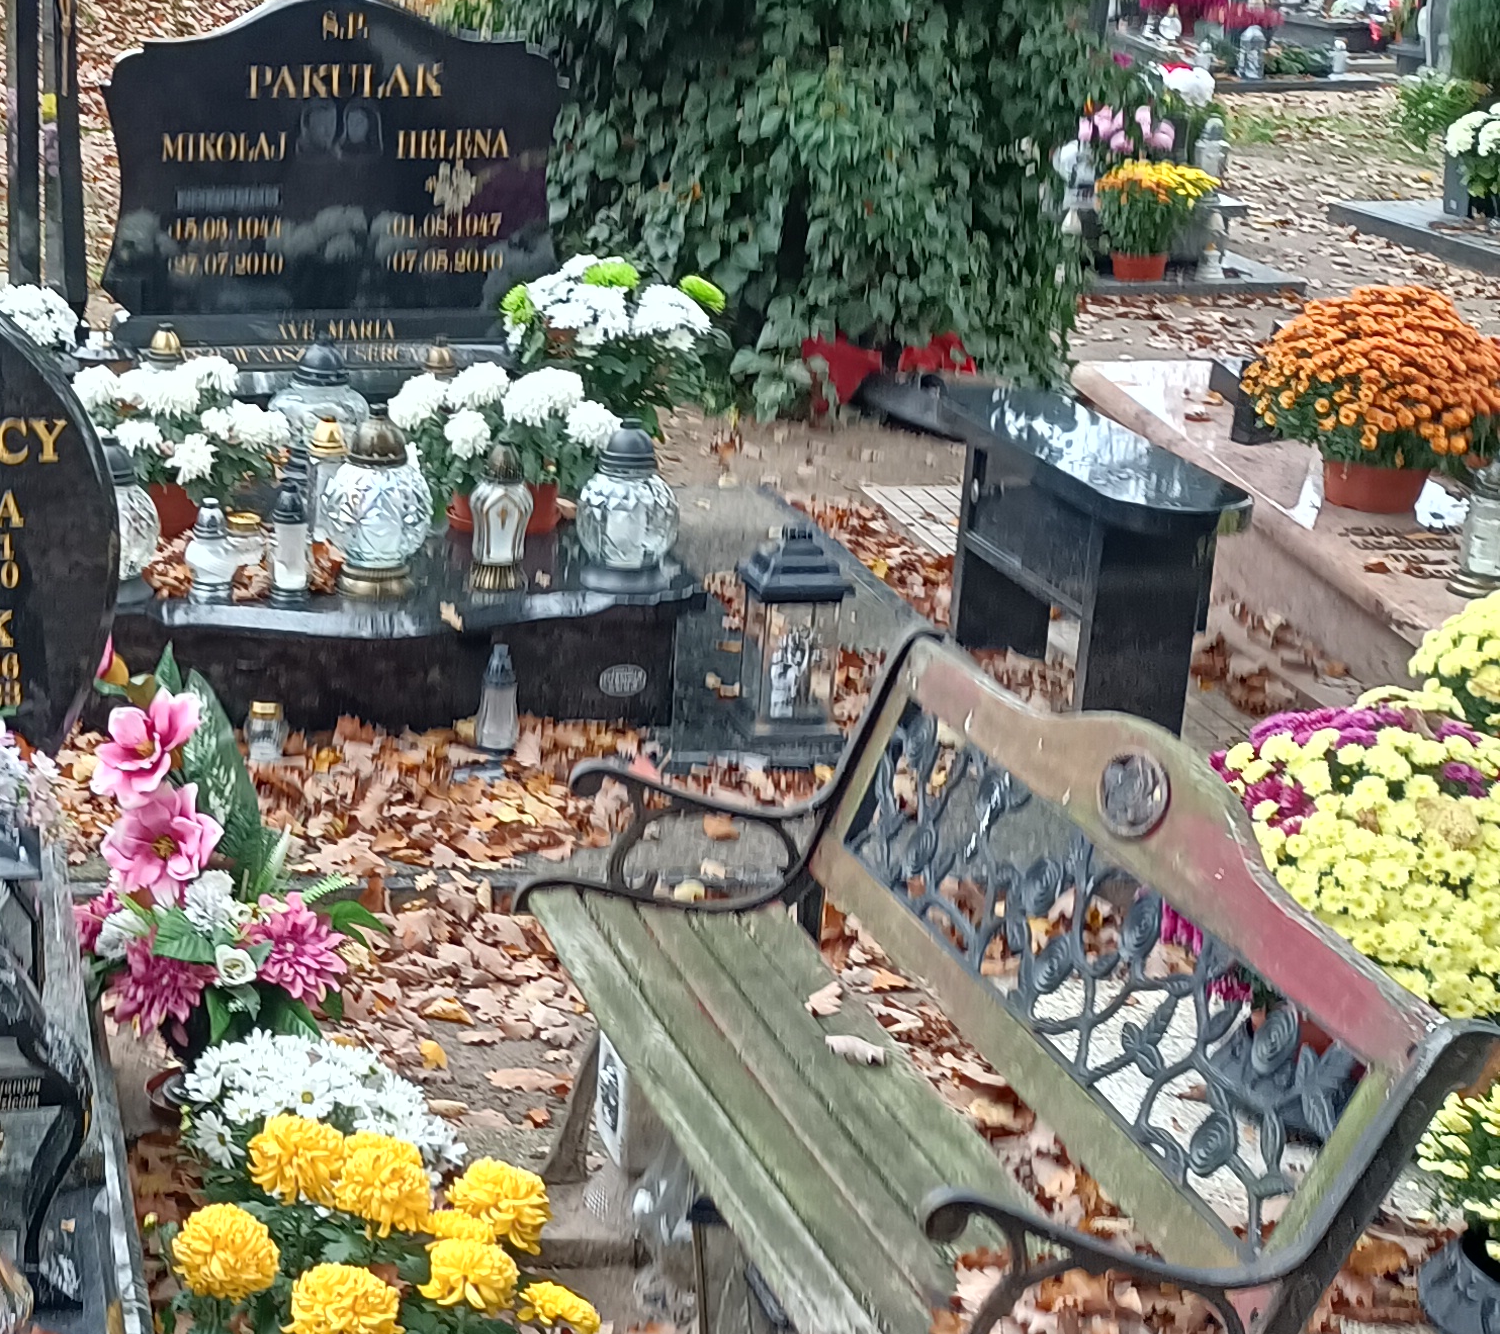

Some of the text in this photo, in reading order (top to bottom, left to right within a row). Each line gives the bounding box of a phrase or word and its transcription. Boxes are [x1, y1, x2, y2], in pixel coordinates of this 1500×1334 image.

[246, 62, 443, 100] PAKULAK
[396, 128, 510, 160] HELENA
[329, 318, 394, 342] MARIA
